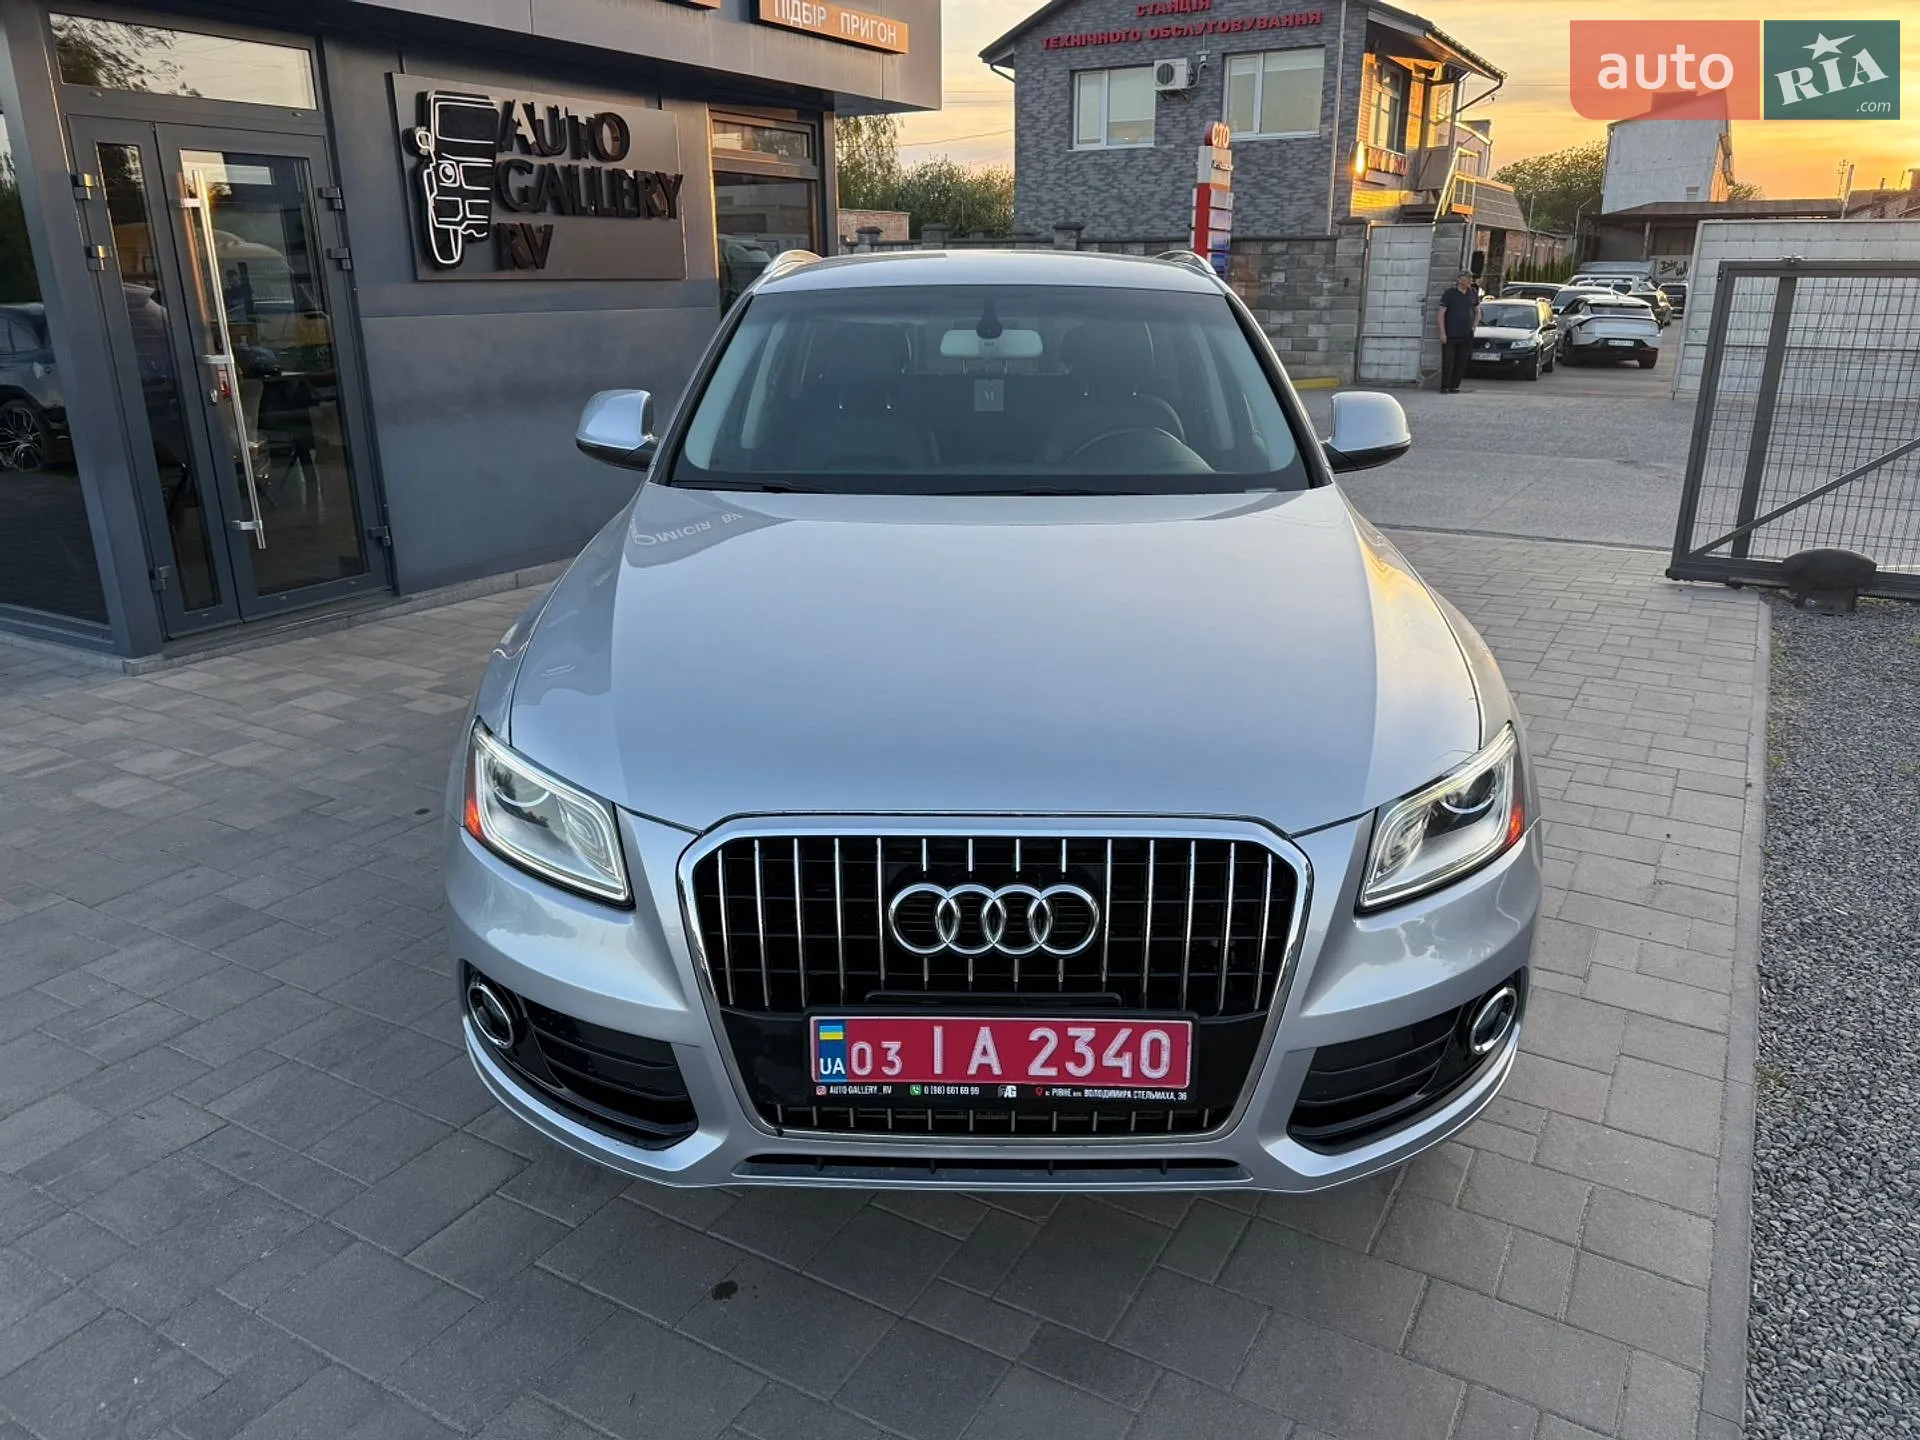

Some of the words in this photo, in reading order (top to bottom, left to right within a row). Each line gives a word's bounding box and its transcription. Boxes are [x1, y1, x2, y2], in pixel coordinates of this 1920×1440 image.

[774, 0, 827, 28] ПІДБІР
[840, 12, 897, 46] ПРИГОН
[1041, 29, 1142, 50] ТЕХНІЧНОГО
[1149, 11, 1323, 40] ОБСЛУГОВУВАННЯ
[1136, 0, 1212, 17] СТАНЦІЯ
[499, 99, 631, 163] AUTO
[496, 158, 684, 220] GALLERY
[496, 222, 553, 270] RV
[820, 1058, 845, 1075] UA
[850, 1041, 903, 1076] 03
[1027, 1027, 1172, 1078] 2340
